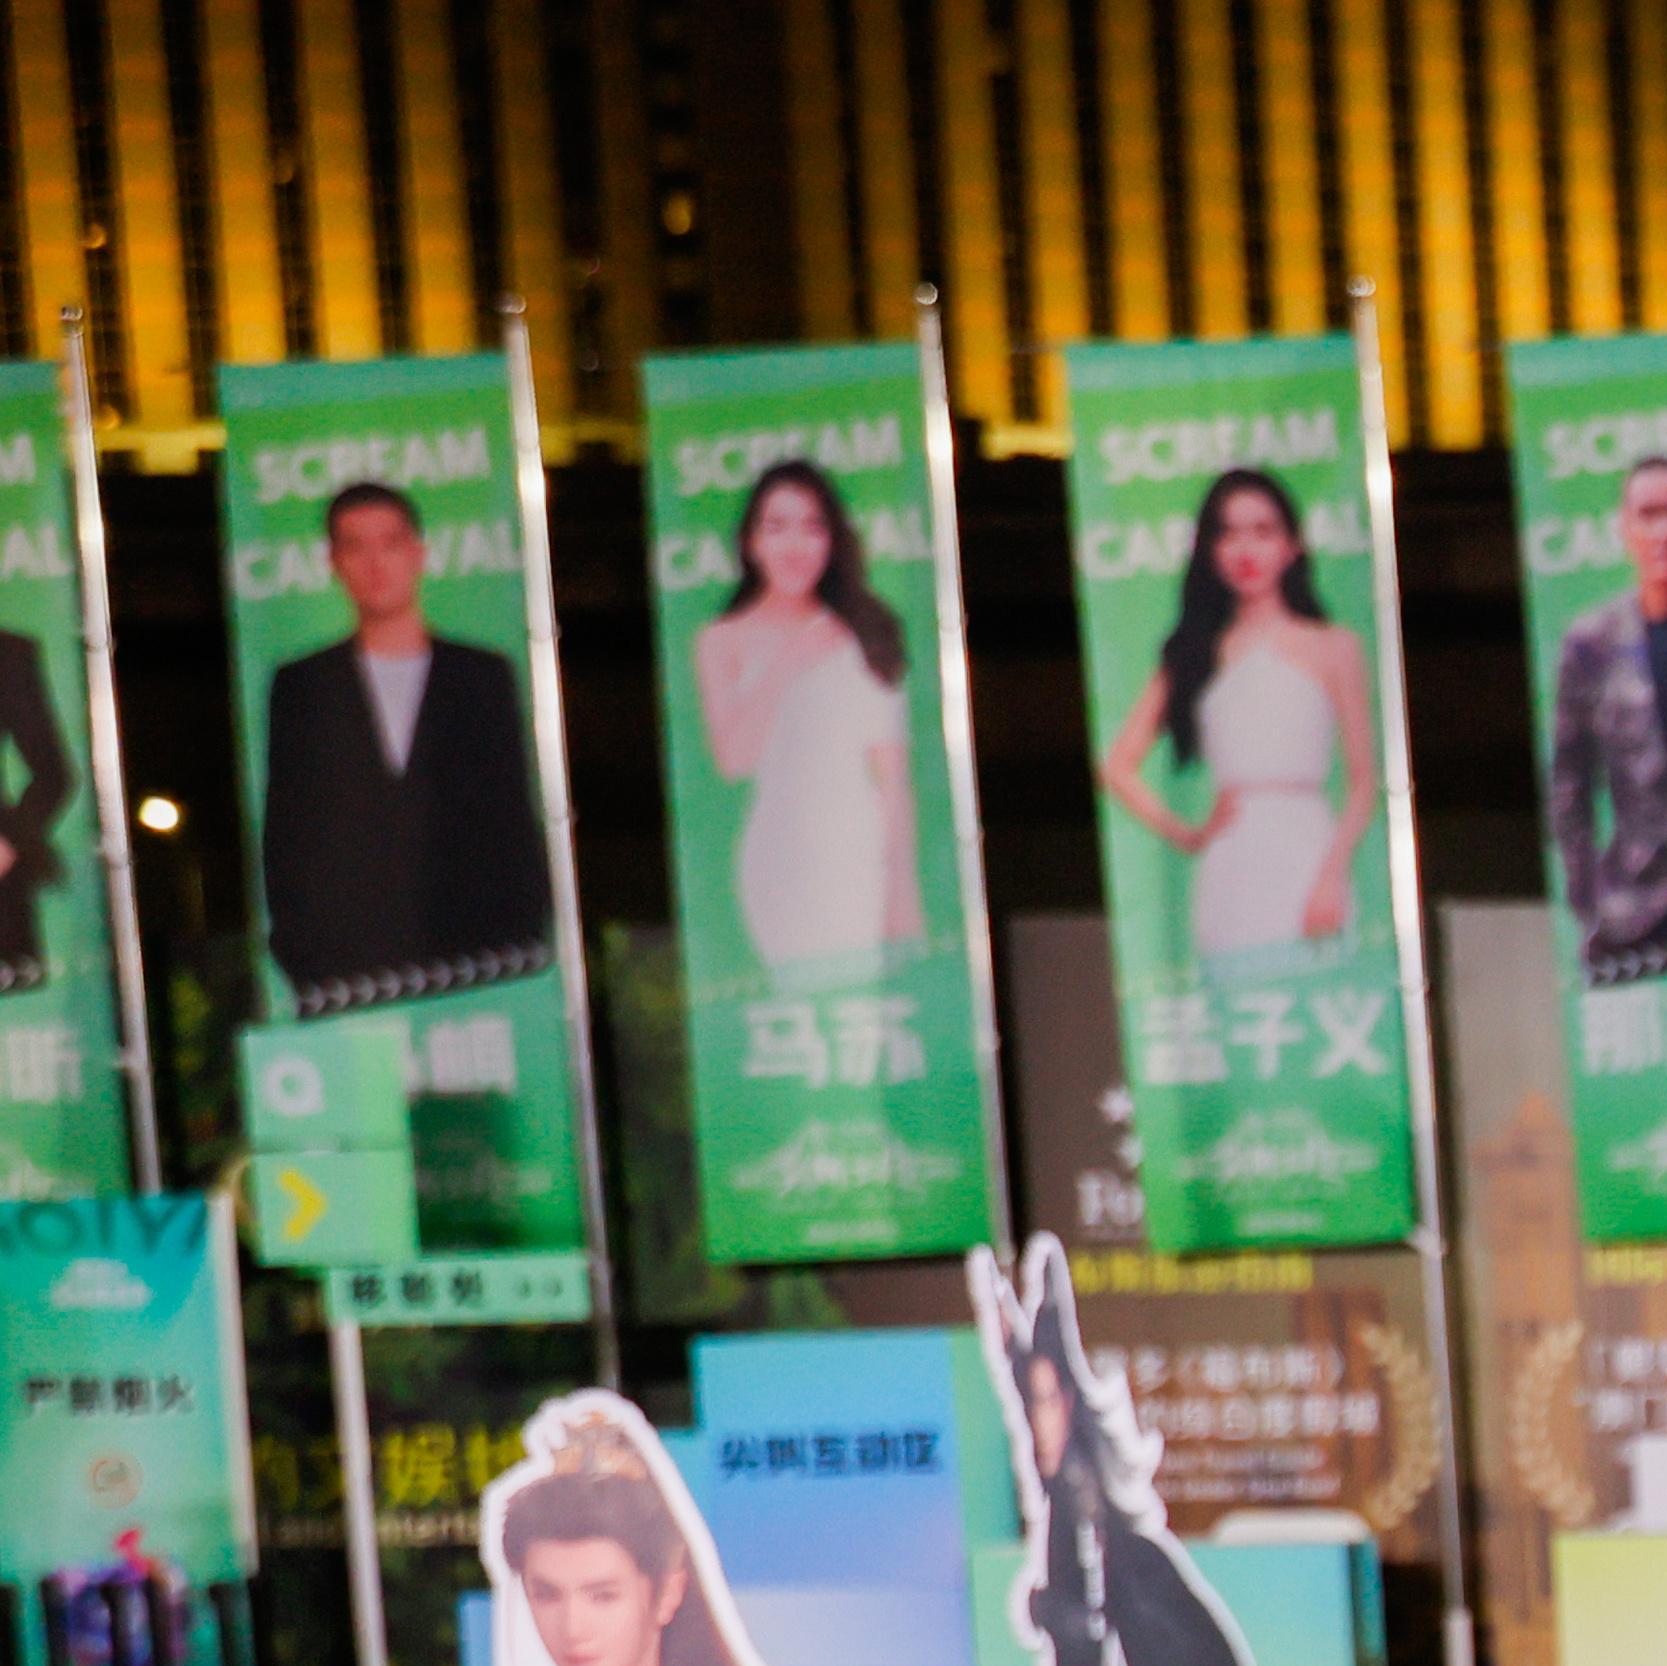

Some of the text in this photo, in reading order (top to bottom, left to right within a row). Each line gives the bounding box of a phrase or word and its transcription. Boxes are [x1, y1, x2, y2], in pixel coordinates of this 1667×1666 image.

[255, 426, 491, 503] SCREAM
[1101, 408, 1340, 484] SCREAM
[237, 519, 520, 600] CAVAL
[660, 507, 930, 592] CAAL
